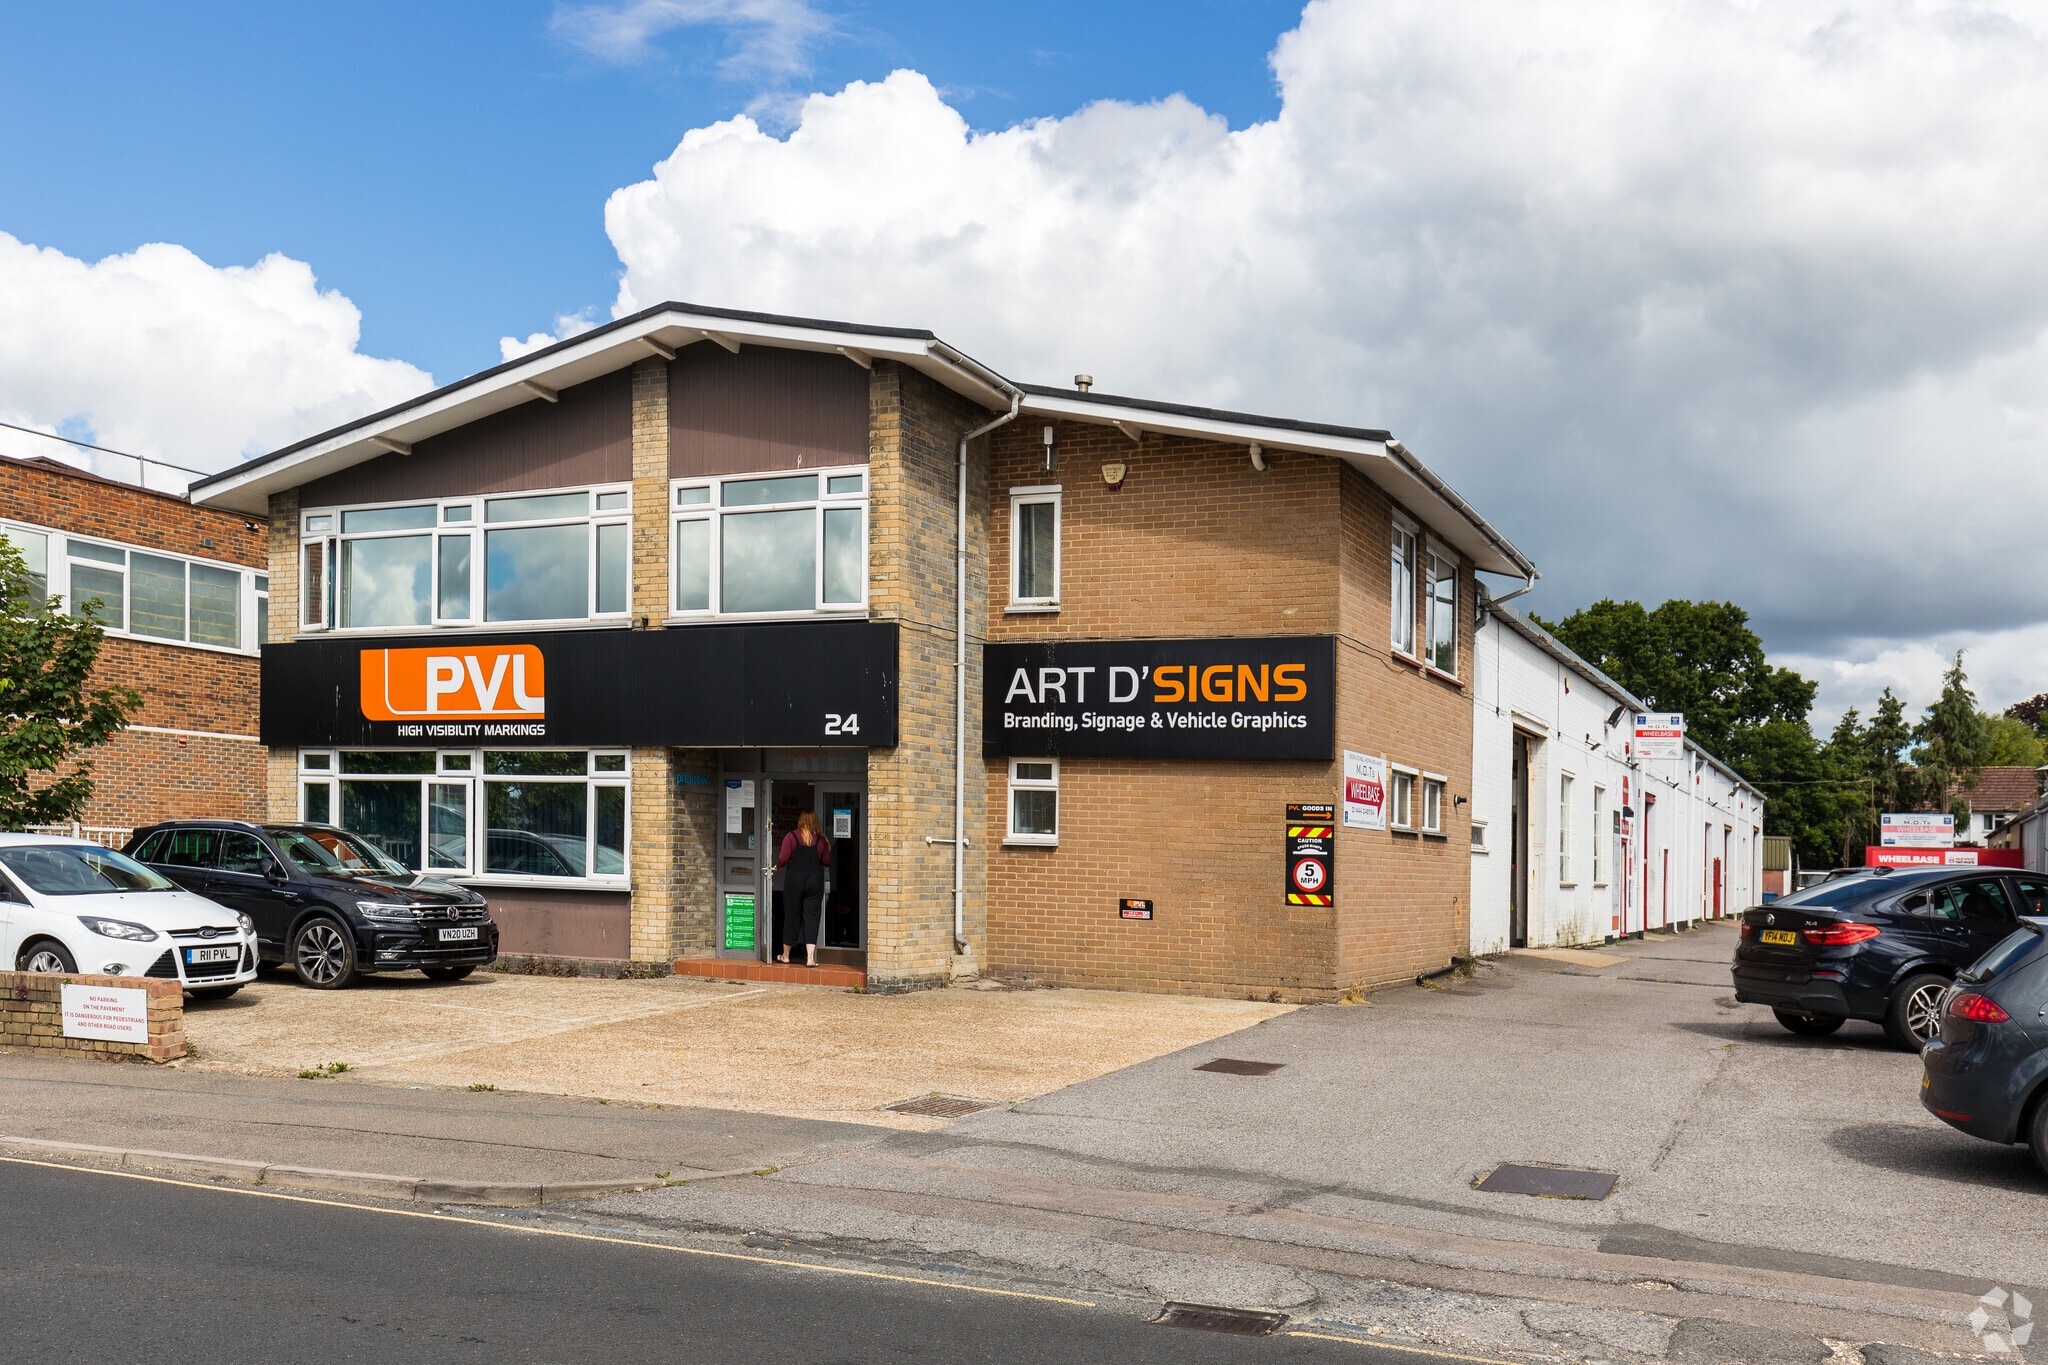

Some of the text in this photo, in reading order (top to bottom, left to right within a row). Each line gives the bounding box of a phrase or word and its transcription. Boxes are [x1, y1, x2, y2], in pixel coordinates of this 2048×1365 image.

[426, 653, 545, 713] PVL
[1004, 666, 1096, 704] ART
[824, 713, 860, 736] 24
[1004, 711, 1307, 732] Branding, Signage & Vehicle Graphics
[397, 724, 545, 736] HIGH VISIBILITY MARKINGS
[675, 773, 709, 786] preview
[1350, 782, 1381, 803] WHEELBASE
[1878, 854, 1940, 864] WHEELBASE
[1304, 863, 1315, 877] 5
[442, 929, 476, 939] VN20 UZH
[1764, 929, 1778, 941] YF14
[214, 949, 230, 960] PVL
[113, 1016, 145, 1024] PEDESTRIANS
